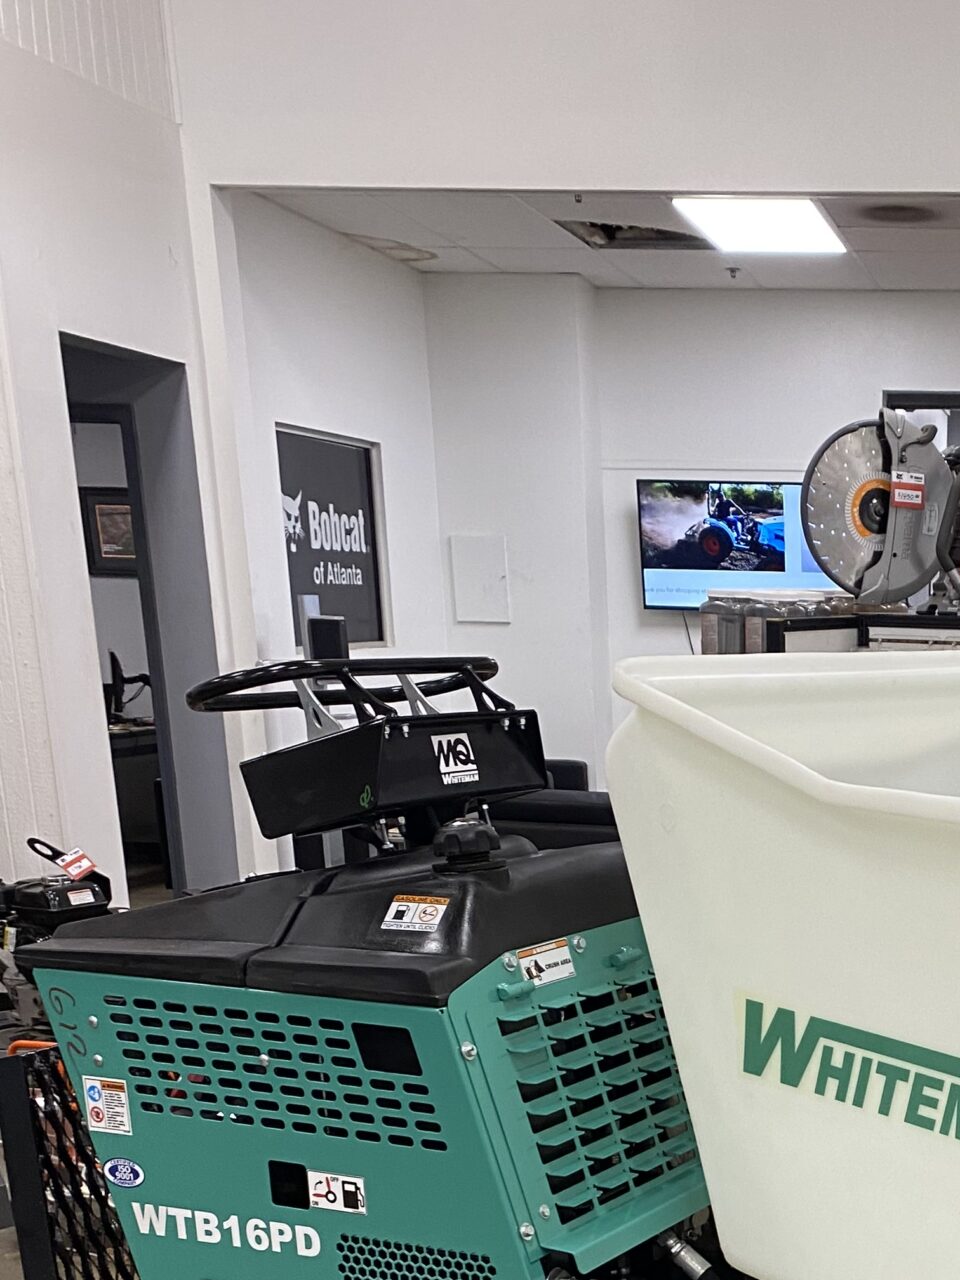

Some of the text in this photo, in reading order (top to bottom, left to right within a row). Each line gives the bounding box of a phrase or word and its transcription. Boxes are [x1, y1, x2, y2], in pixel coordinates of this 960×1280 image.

[307, 500, 366, 553] Bobcat
[313, 561, 363, 585] of Atlanta
[434, 736, 476, 769] MQ
[115, 1171, 134, 1180] 9001
[117, 1165, 131, 1173] ISO
[131, 1202, 321, 1257] WTB16PD
